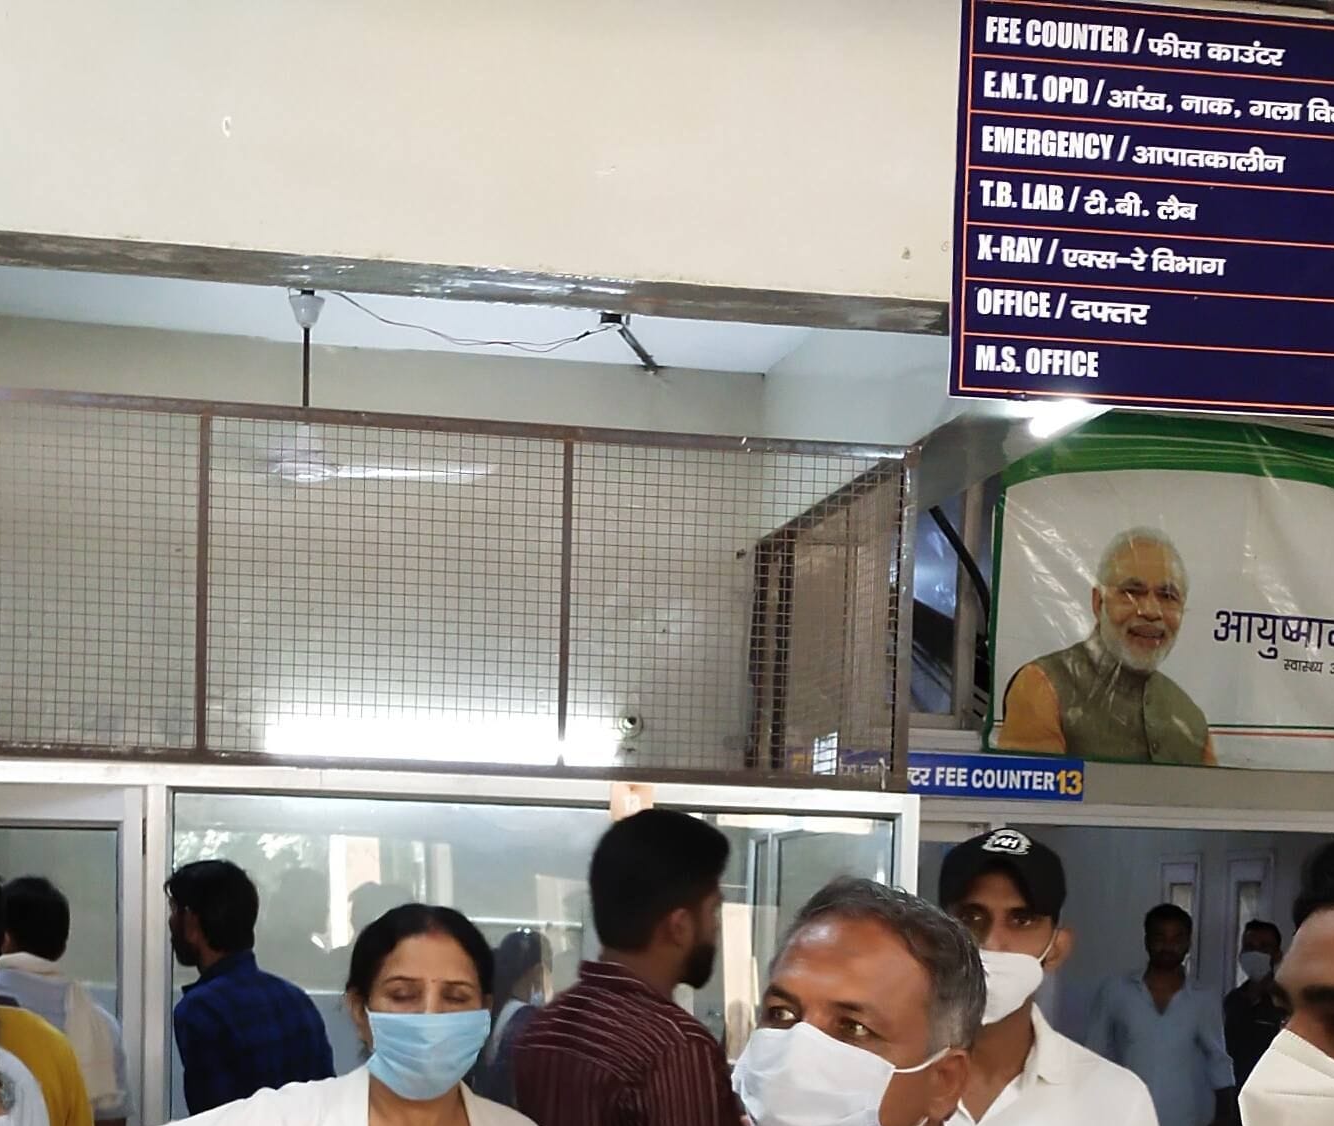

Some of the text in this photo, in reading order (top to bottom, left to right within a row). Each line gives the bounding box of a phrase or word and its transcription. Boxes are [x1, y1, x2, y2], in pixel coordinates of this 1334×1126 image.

[986, 16, 1285, 66] FEE COUNTER / फीस काउंटर
[984, 71, 1038, 100] E.N.T.
[1043, 76, 1088, 103] OPD
[1093, 80, 1105, 105] /
[1107, 85, 1173, 113] आंख,
[1181, 95, 1241, 118] नाक,
[1249, 101, 1302, 120] गला
[982, 126, 1286, 173] EMERGENCY / आपातकालीन
[980, 180, 1198, 220] T.B. LAB / टी.बी. लैब
[978, 234, 1043, 263] X-RAY
[1047, 239, 1059, 264] /
[1151, 248, 1226, 275] विभाग
[977, 288, 1150, 325] OFFICE / दफ्तर
[976, 345, 1098, 377] M.S. OFFICE
[1283, 659, 1324, 673] स्वास्थ्य
[908, 767, 1083, 795] टर FEE COUNTER 13
